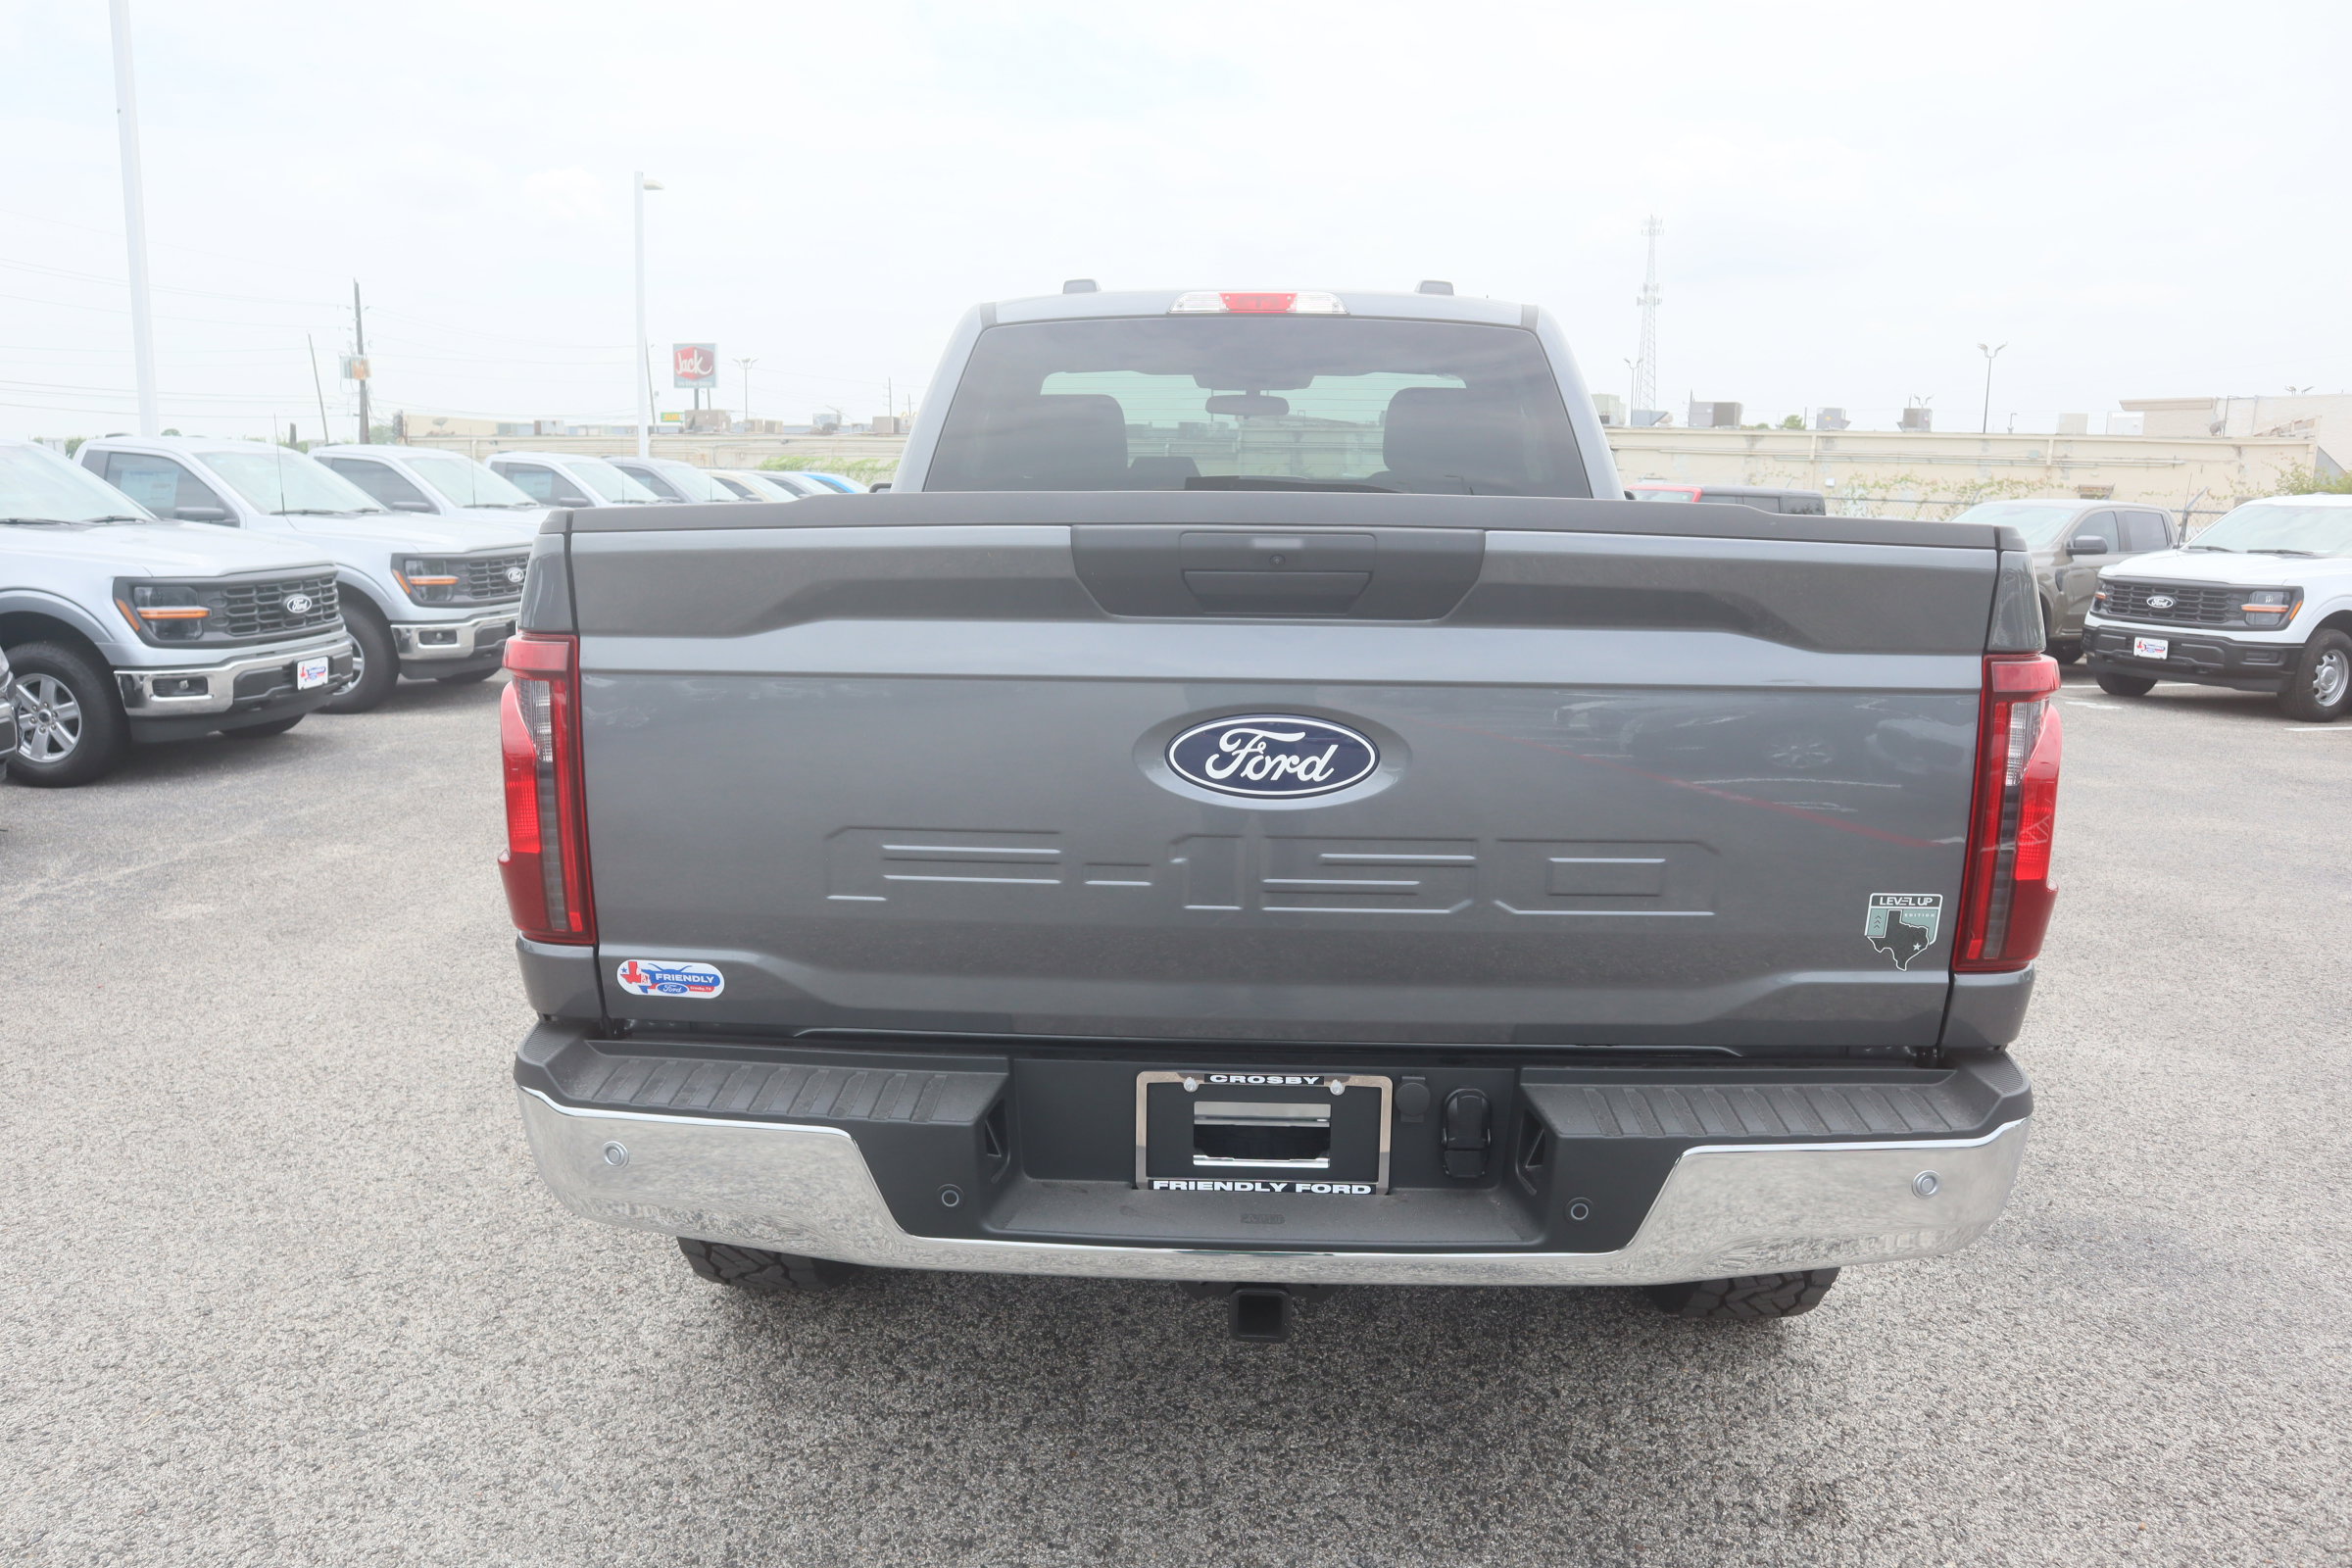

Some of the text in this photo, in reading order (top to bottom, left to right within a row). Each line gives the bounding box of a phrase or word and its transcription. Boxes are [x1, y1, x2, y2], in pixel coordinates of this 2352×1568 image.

[675, 349, 712, 374] Jack
[1204, 727, 1340, 782] Ford
[825, 827, 1719, 915] F-150
[1880, 896, 1934, 906] LEVEL UP
[655, 972, 714, 984] FRIENDLY
[662, 984, 682, 993] Ford
[1209, 1074, 1320, 1085] CROSBY
[1152, 1180, 1372, 1195] FRIENDLY FORD
